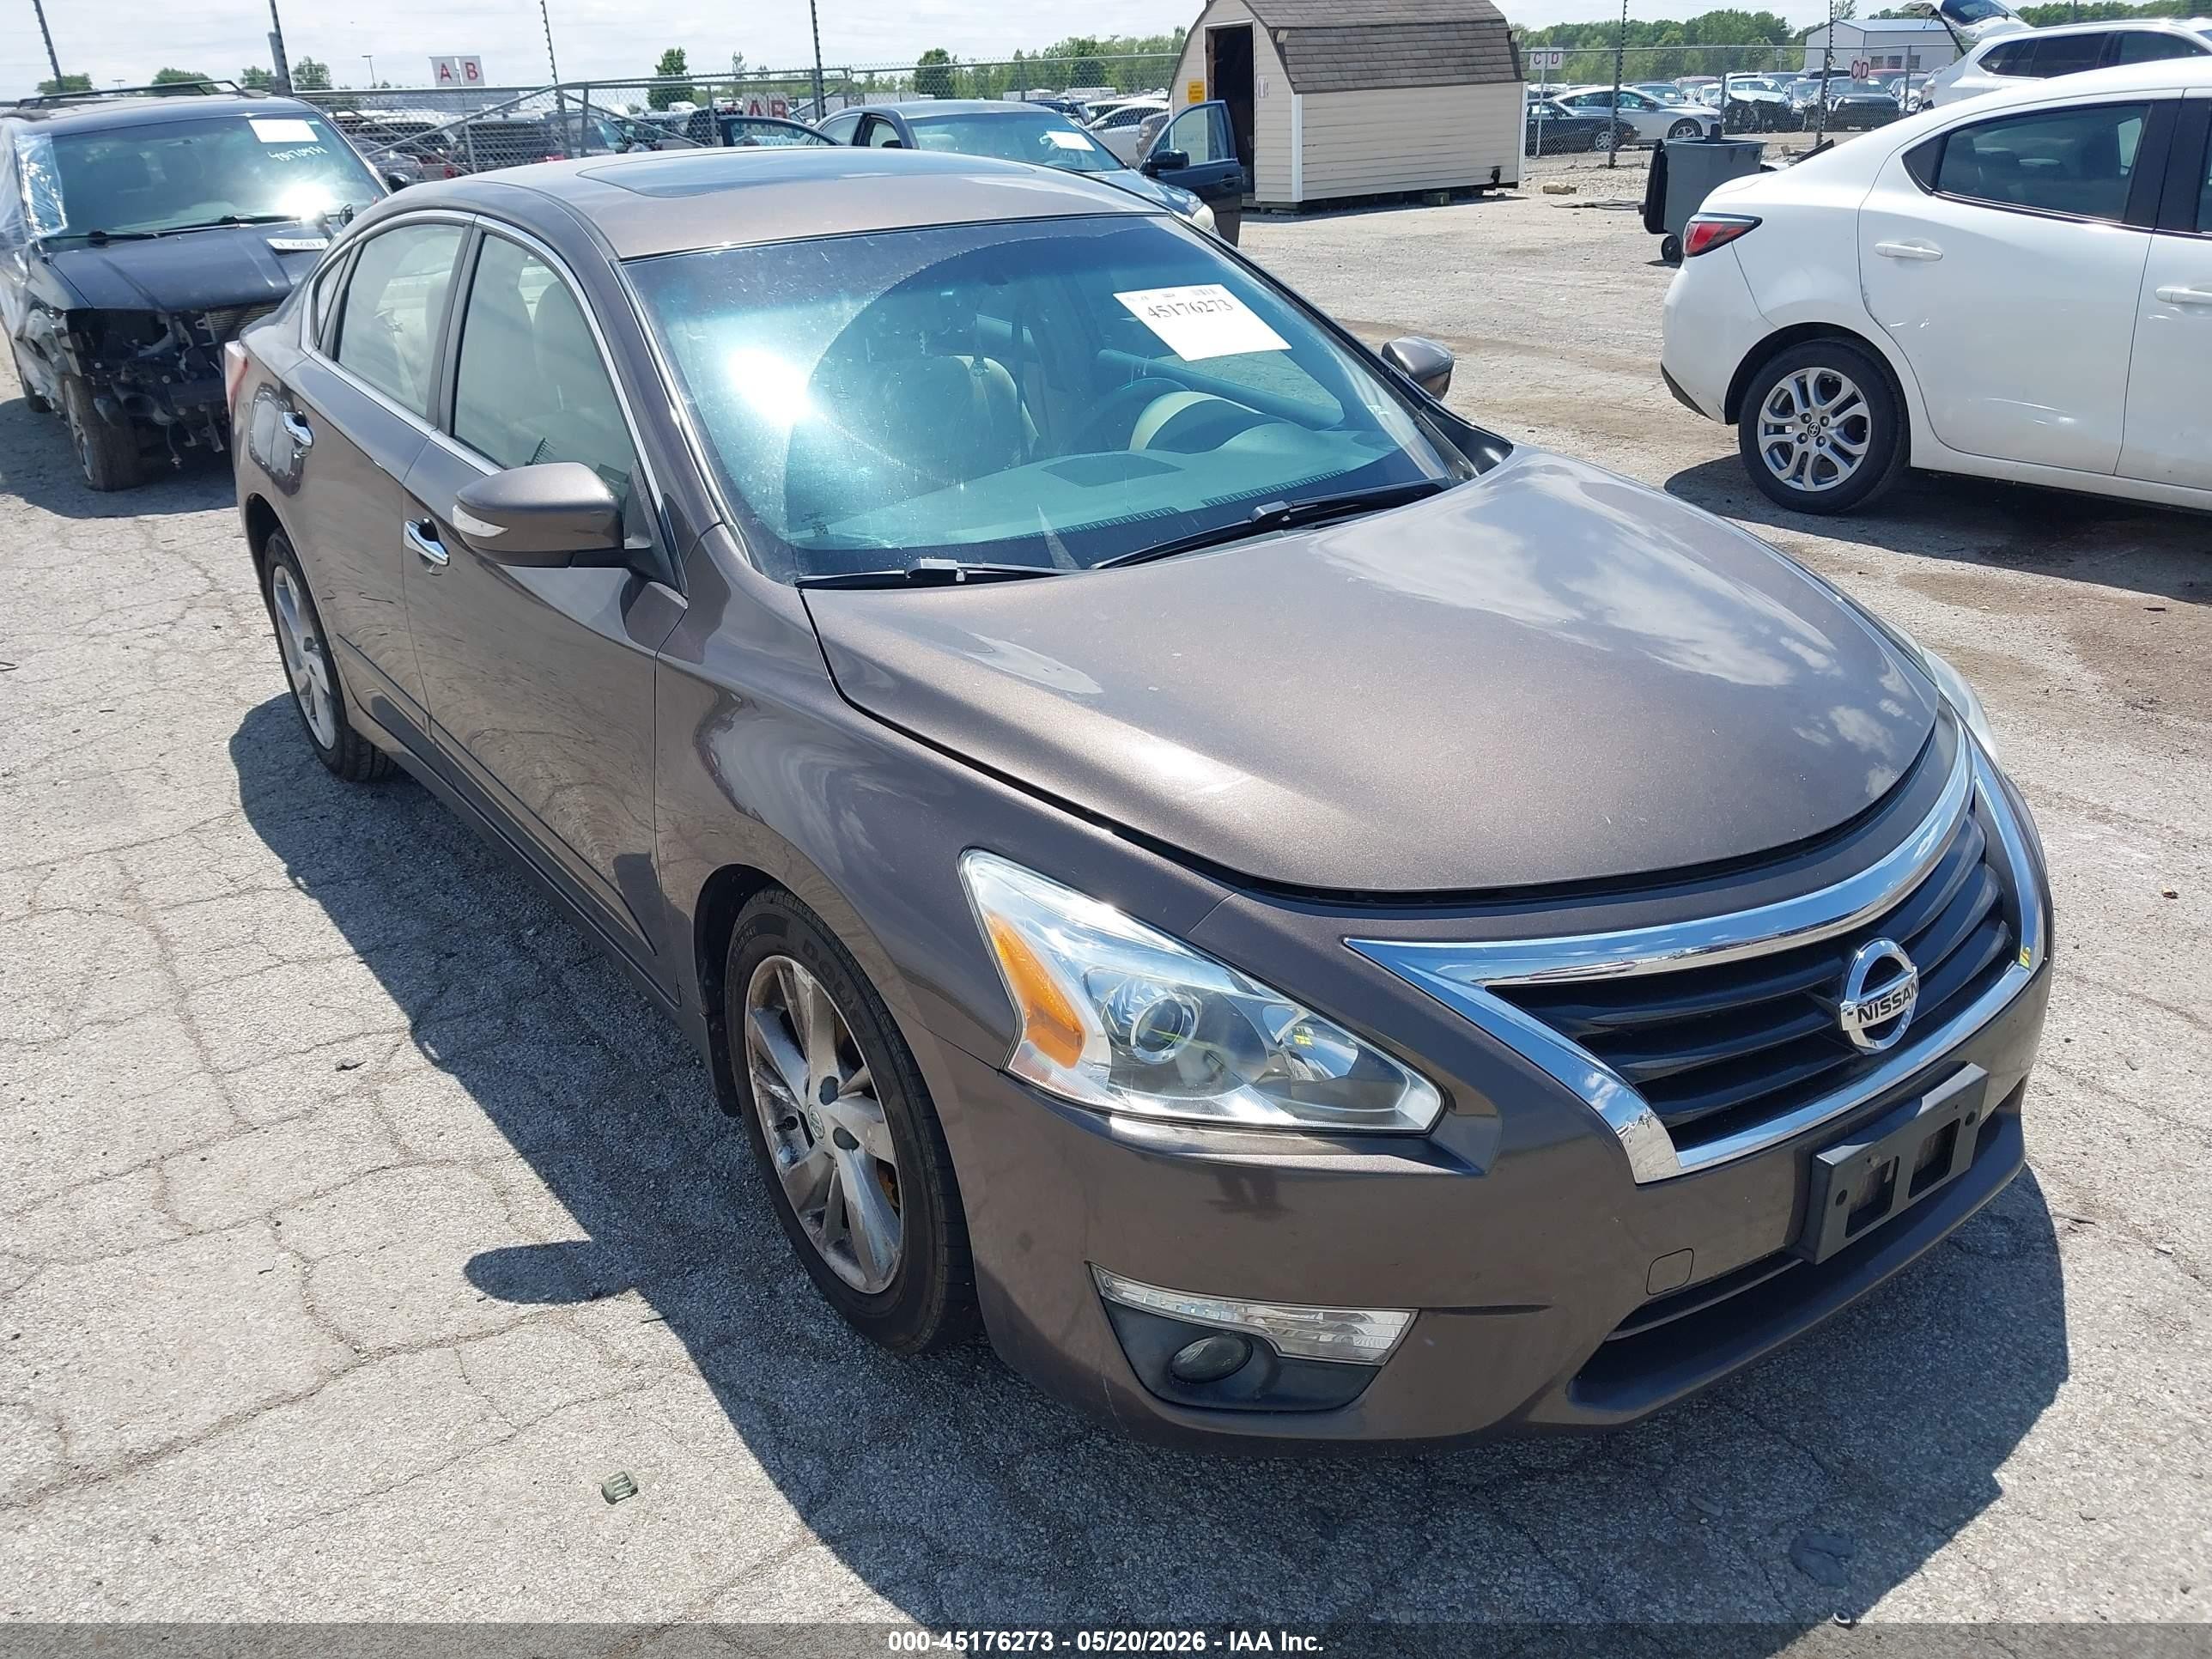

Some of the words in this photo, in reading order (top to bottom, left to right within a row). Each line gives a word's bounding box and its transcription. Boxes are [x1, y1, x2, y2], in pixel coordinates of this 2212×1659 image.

[1533, 52, 1542, 65] C
[1551, 52, 1559, 65] D
[440, 62, 453, 82] A
[465, 62, 479, 81] B
[1850, 59, 1860, 79] C
[1860, 61, 1869, 79] D
[748, 98, 763, 117] A
[770, 100, 788, 118] B
[1147, 299, 1234, 319] 45176273
[1856, 977, 1919, 1024] NISSAN
